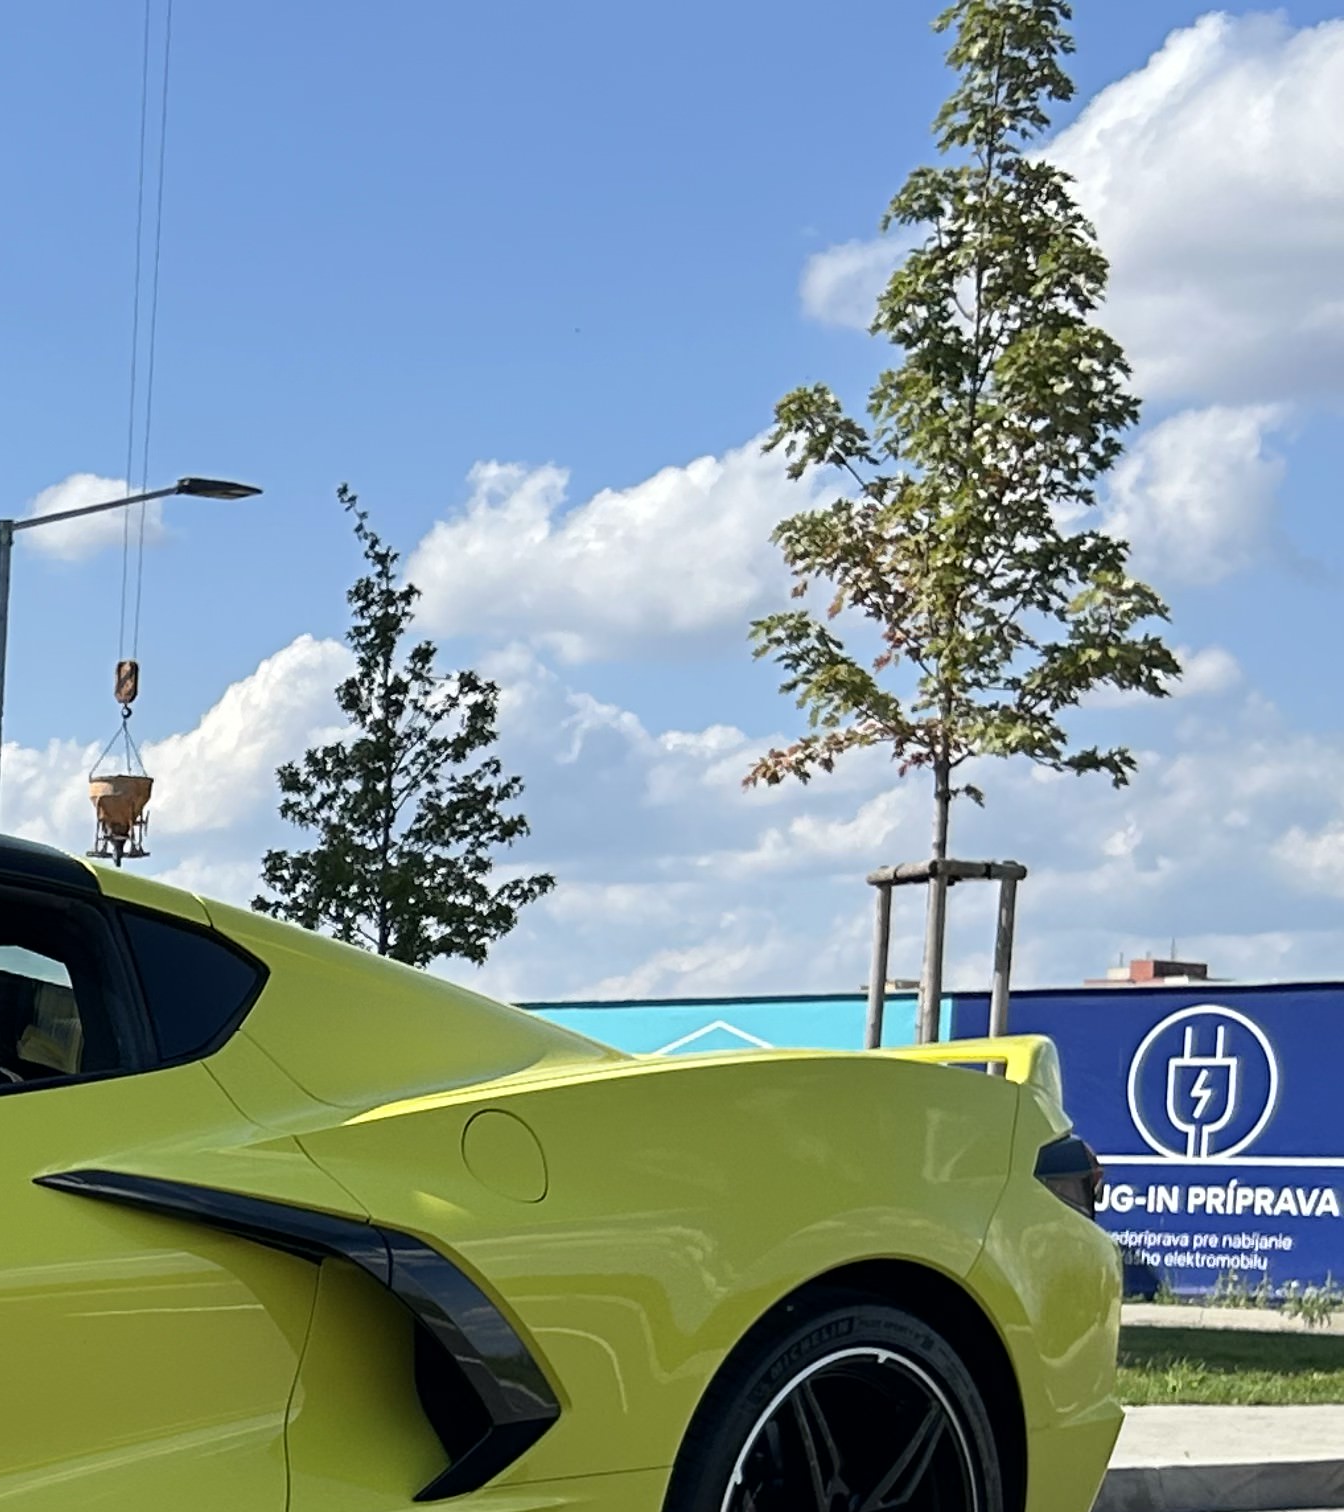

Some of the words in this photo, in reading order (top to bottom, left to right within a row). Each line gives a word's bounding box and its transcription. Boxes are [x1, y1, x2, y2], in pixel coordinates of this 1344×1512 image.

[1094, 1184, 1179, 1213] UG-IN
[1187, 1179, 1339, 1217] PRÍPRAVA
[1193, 1233, 1219, 1250] pre
[1164, 1250, 1267, 1270] elektromobilu
